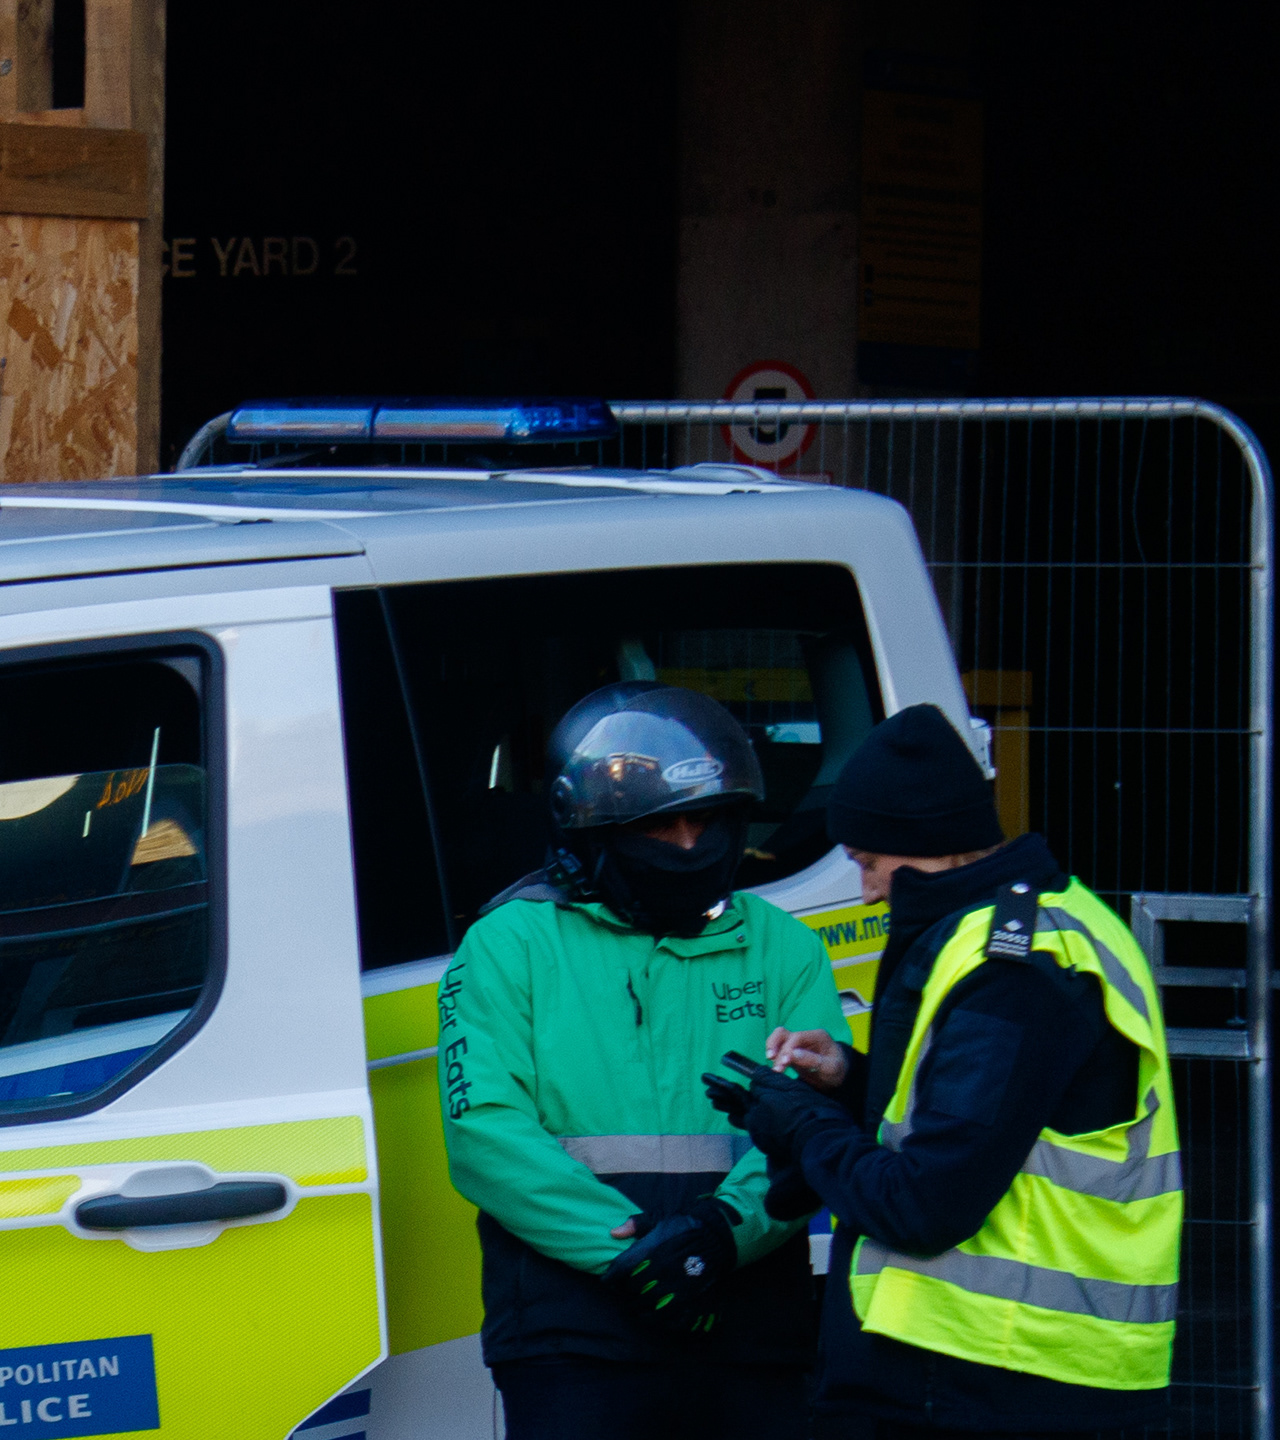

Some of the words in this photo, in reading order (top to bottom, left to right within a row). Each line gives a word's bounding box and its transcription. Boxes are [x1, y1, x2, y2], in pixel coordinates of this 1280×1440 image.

[163, 236, 197, 278] E
[209, 235, 321, 277] YARD
[333, 235, 358, 277] 2
[439, 963, 466, 1032] Uber
[712, 980, 764, 1001] Uber
[715, 1000, 766, 1023] Eats
[445, 1036, 472, 1120] Eats
